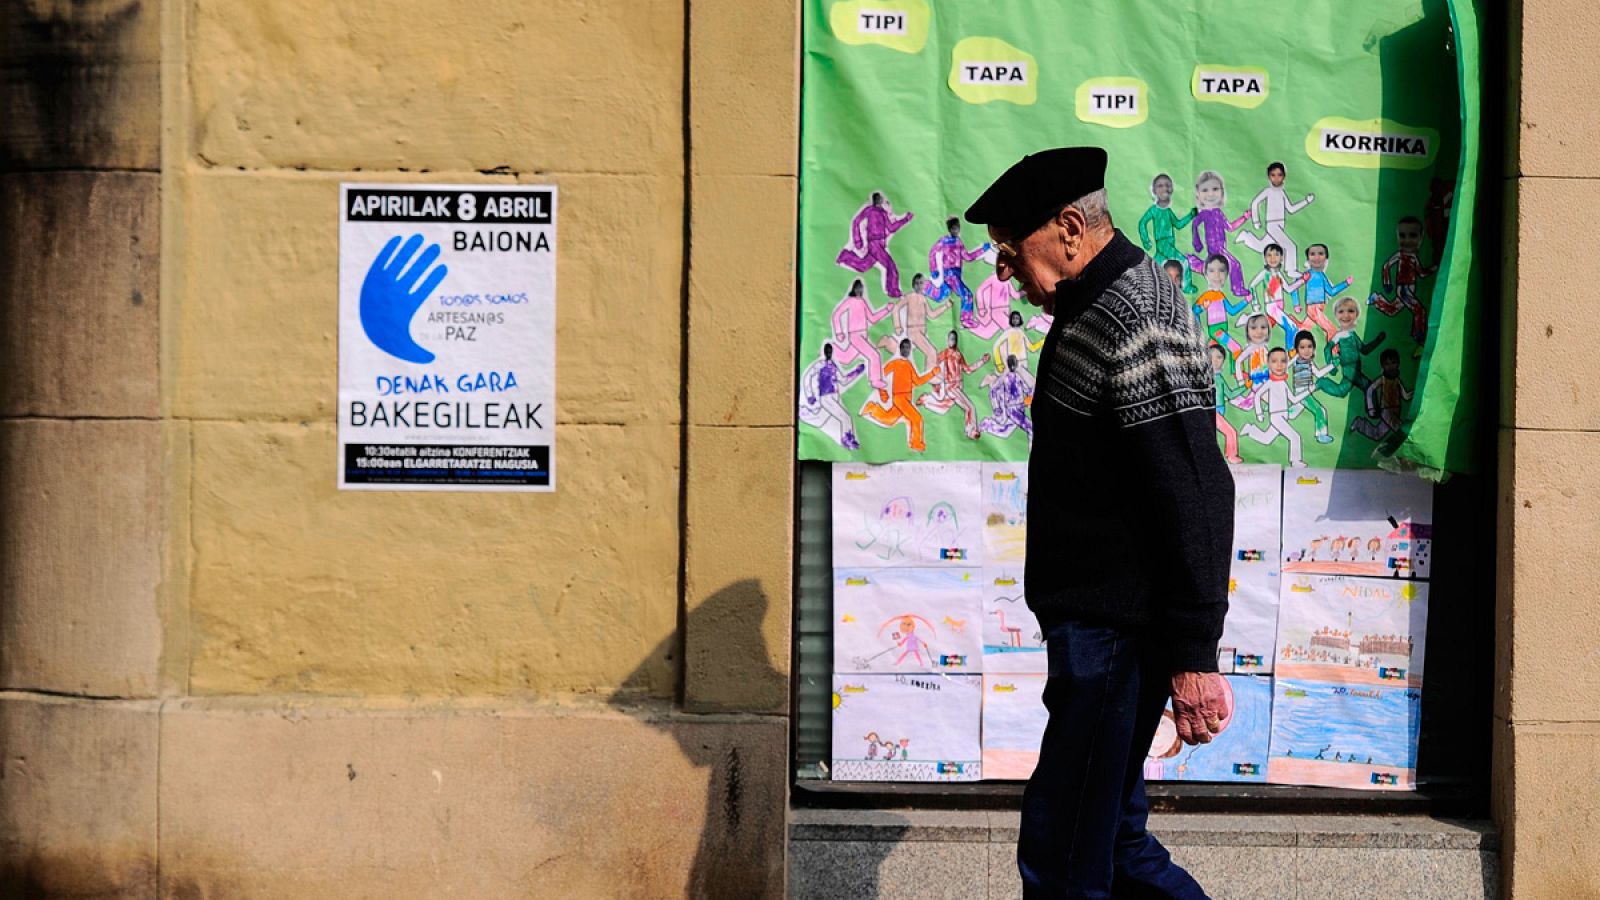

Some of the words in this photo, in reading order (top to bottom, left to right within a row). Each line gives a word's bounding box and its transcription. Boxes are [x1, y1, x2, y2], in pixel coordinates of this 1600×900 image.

[861, 14, 903, 30] TIPI
[966, 66, 1024, 81] TAPA
[1203, 78, 1260, 93] TAPA
[1093, 94, 1134, 109] TIPI
[1326, 134, 1426, 155] KORRIKA
[351, 195, 451, 217] APIRILAK
[457, 192, 477, 221] 8
[483, 196, 548, 218] ABRIL
[453, 231, 550, 251] BAIONA
[485, 292, 529, 305] SOMOS
[428, 312, 505, 326] ARTESAN@S
[445, 326, 477, 341] PAZ
[376, 374, 449, 396] DENAK
[457, 371, 518, 393] GARA
[351, 401, 543, 430] BAKEGILEAK
[452, 448, 530, 458] KONFERENTZIAK
[404, 458, 493, 469] ELGARRETARATZE
[494, 459, 539, 470] NAGUSIA
